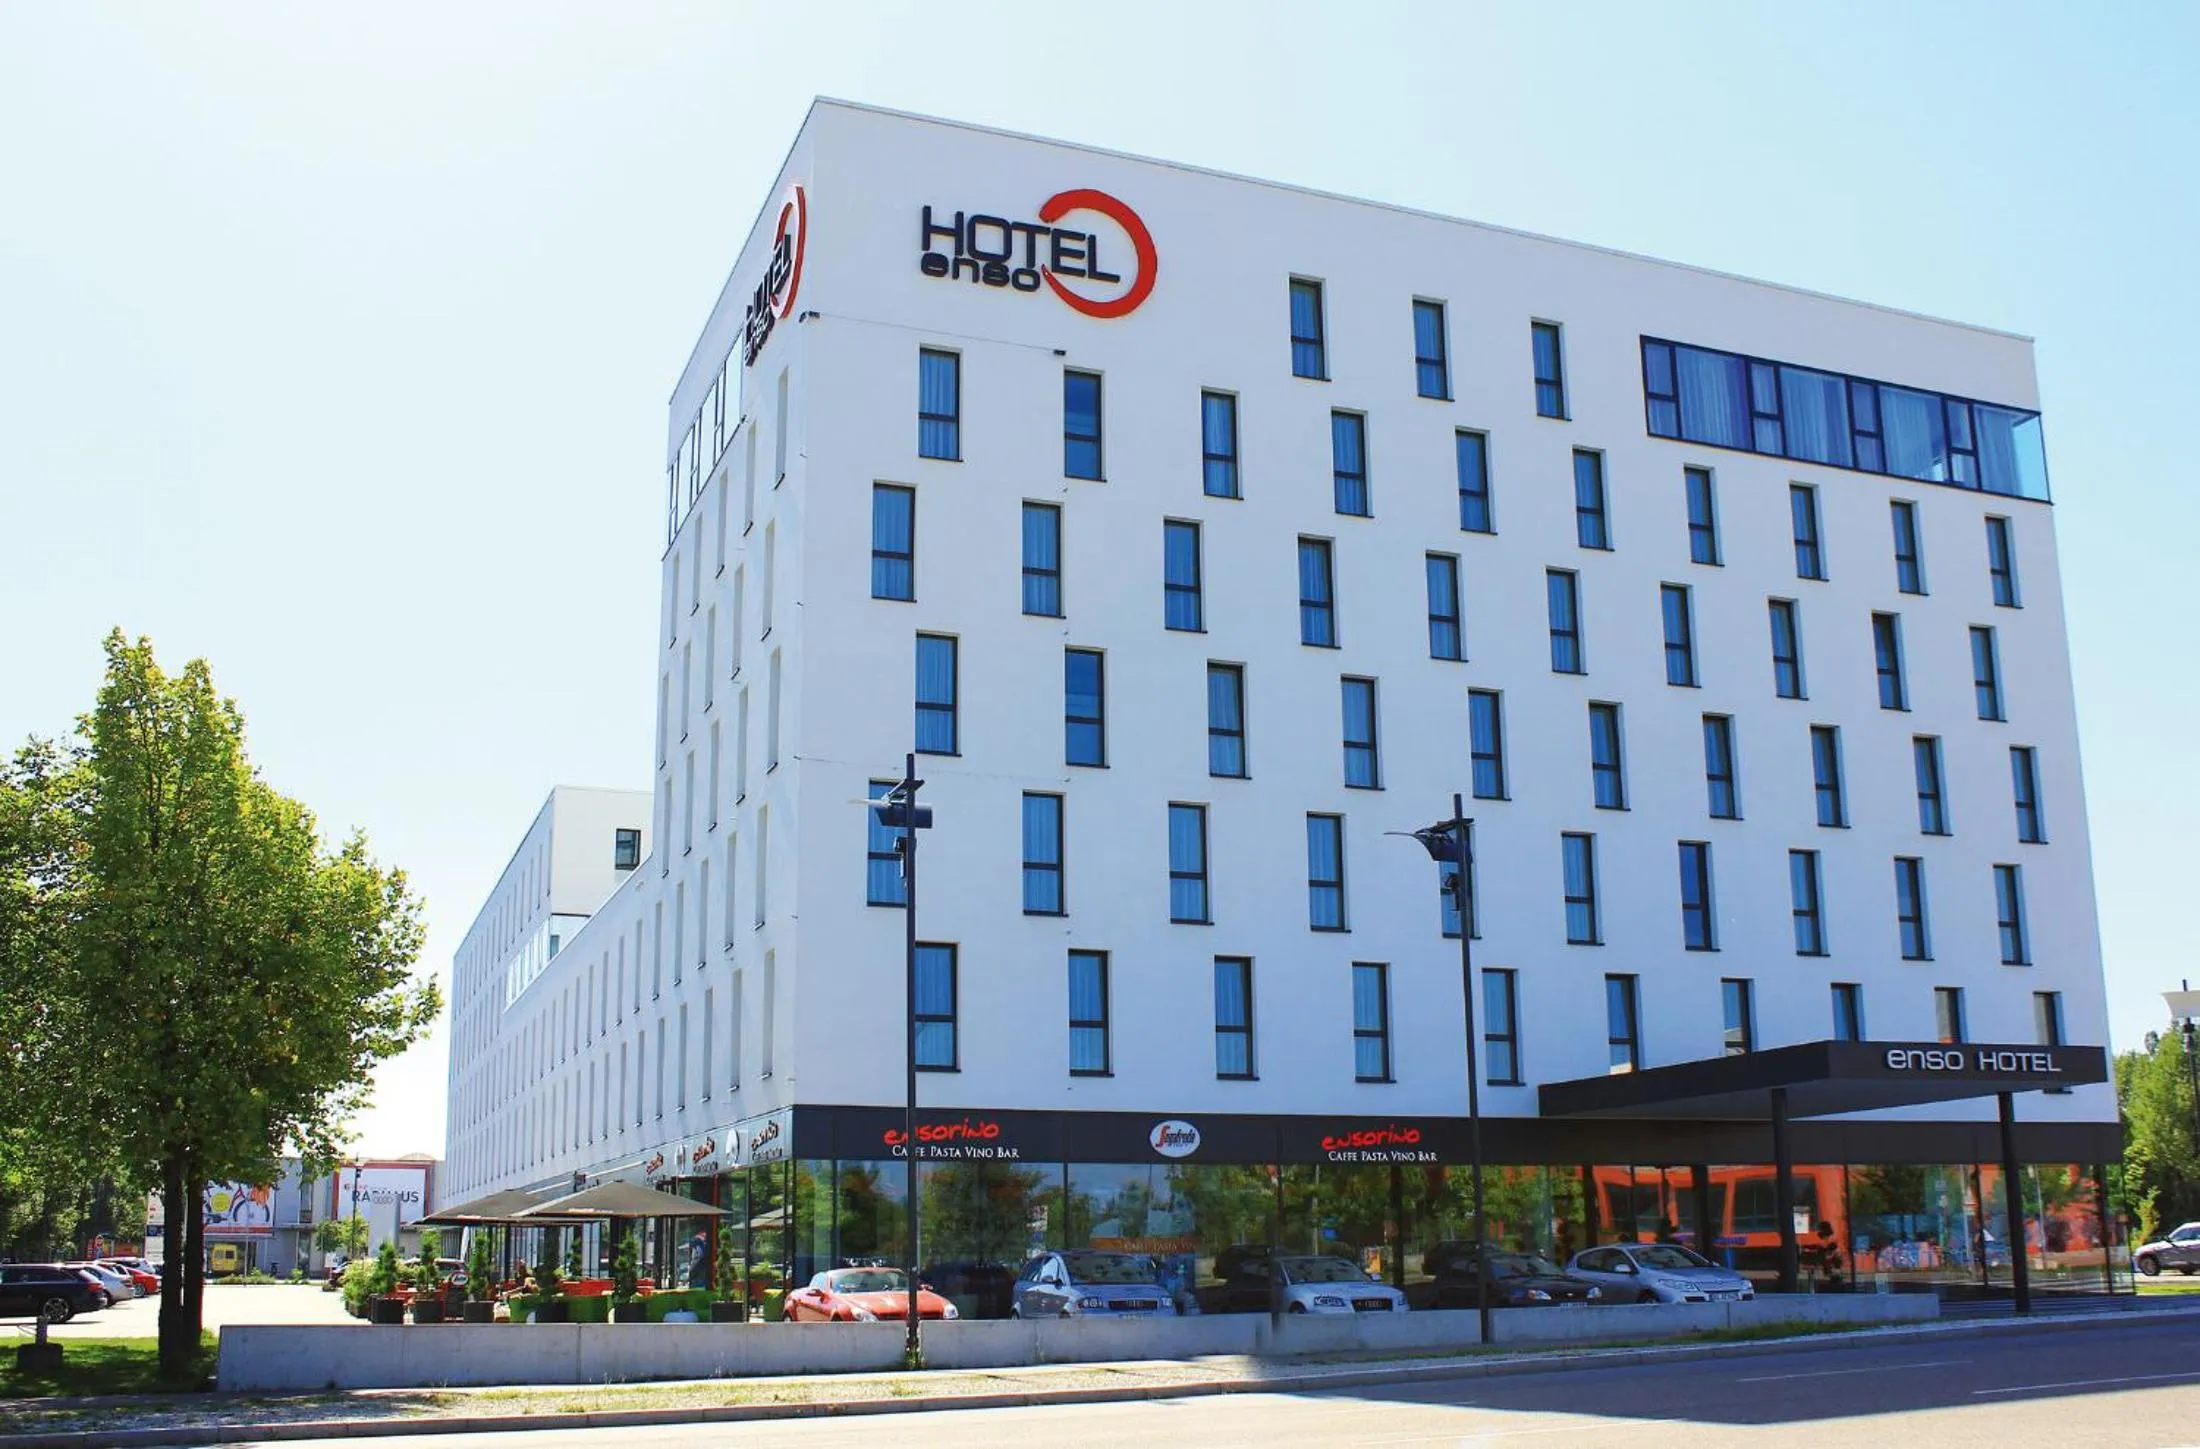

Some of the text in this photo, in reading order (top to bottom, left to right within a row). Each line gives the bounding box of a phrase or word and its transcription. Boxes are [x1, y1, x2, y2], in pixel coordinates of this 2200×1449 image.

[922, 204, 1121, 284] HOTEL
[920, 251, 1041, 293] enso
[1886, 1049, 2062, 1072] enso HOTEL
